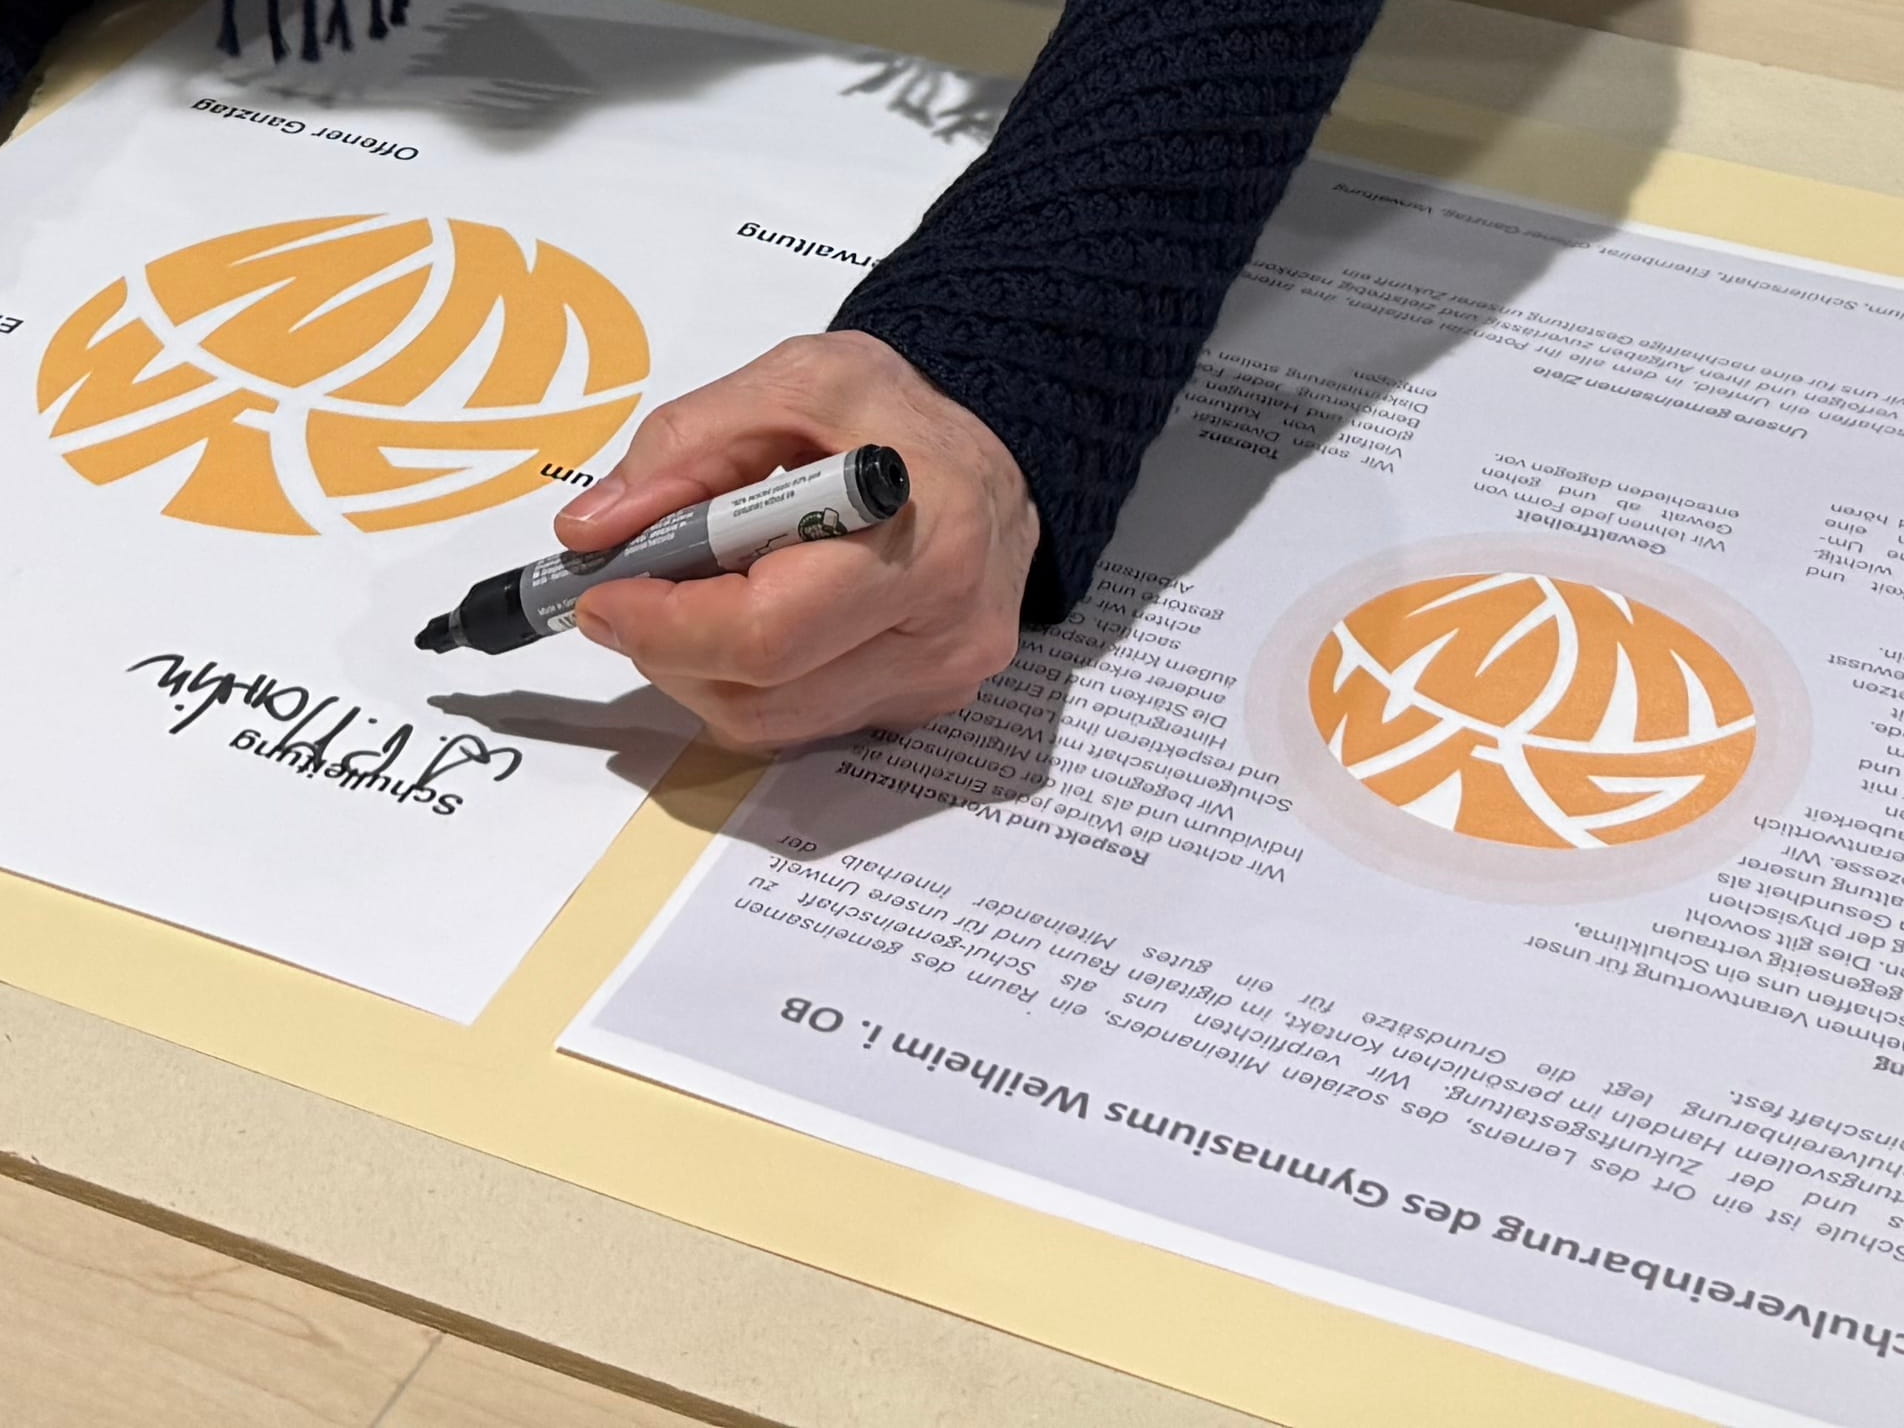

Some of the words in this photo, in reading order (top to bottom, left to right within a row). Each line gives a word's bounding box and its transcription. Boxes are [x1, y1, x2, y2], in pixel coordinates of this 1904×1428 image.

[192, 97, 306, 135] Ganztag
[312, 125, 420, 163] Offener
[736, 222, 881, 268] rwaltung
[1198, 429, 1278, 460] Toleranz
[1515, 508, 1667, 555] Gewaltfreiheit
[229, 729, 463, 816] Schulleitung
[1858, 758, 1901, 777] und
[835, 760, 1001, 824] Wertschätzung
[1861, 779, 1898, 797] mit
[1005, 813, 1051, 834] und
[775, 835, 818, 861] der
[1054, 826, 1150, 866] Respekt
[1780, 845, 1821, 867] Wir
[748, 876, 779, 892] zu
[769, 855, 861, 897] Umwelt.
[841, 854, 952, 900] innerhalb
[1717, 872, 1752, 889] als
[1737, 855, 1826, 887] unserer
[868, 888, 949, 921] unsere
[1708, 892, 1843, 937] physischen
[1756, 881, 1892, 930] Gesundheit
[734, 897, 904, 955] gemeinsamen
[797, 892, 1036, 977] Schul-gemeinschaft
[952, 916, 990, 936] für
[971, 897, 1118, 951] Miteinander
[990, 928, 1042, 950] und
[1685, 908, 1772, 940] sowohl
[1524, 935, 1591, 963] unser
[1574, 922, 1710, 975] Schulklima,
[1652, 922, 1763, 963] vertrauen
[1776, 932, 1814, 952] gilt
[1845, 930, 1886, 951] der
[911, 952, 956, 974] des
[1048, 944, 1121, 977] Raum
[1141, 947, 1213, 974] gutes
[1595, 955, 1628, 976] für
[1715, 963, 1751, 983] ein
[1817, 944, 1872, 972] Dies
[966, 969, 1040, 1004] Raum
[1059, 973, 1098, 992] als
[1127, 968, 1233, 1007] digitalen
[1235, 974, 1274, 993] ein
[1756, 976, 1800, 997] uns
[1766, 951, 1904, 1001] gegenseitig
[1049, 996, 1088, 1016] ein
[1122, 992, 1168, 1014] uns
[1298, 994, 1336, 1014] für
[1632, 962, 1808, 1028] Verantwortung
[780, 997, 844, 1033] OB
[1240, 1000, 1273, 1022] im
[861, 1020, 883, 1050] i.
[1104, 1010, 1271, 1075] Miteinanders,
[1193, 1013, 1341, 1067] verpflichten
[1284, 1011, 1385, 1055] Kontakt,
[1361, 1012, 1507, 1065] Grundsätze
[891, 1032, 1090, 1120] Weilheim
[1282, 1066, 1389, 1106] sozialen
[1366, 1066, 1411, 1091] Wir
[1391, 1046, 1564, 1103] persönlichen
[1536, 1063, 1576, 1083] die
[1569, 1097, 1603, 1119] im
[1602, 1081, 1654, 1108] legt
[1729, 1090, 1785, 1119] fest.
[1400, 1101, 1449, 1125] des
[1444, 1085, 1703, 1176] Zukunftsgestaltung.
[1466, 1117, 1577, 1166] Lernens,
[1611, 1110, 1726, 1156] Handeln
[1104, 1102, 1389, 1208] Gymnasiums
[1590, 1158, 1640, 1183] des
[1652, 1176, 1696, 1201] Ort
[1727, 1171, 1775, 1193] der
[1401, 1193, 1481, 1235] des
[1712, 1193, 1754, 1214] ein
[1801, 1192, 1857, 1216] und
[1766, 1209, 1802, 1232] ist
